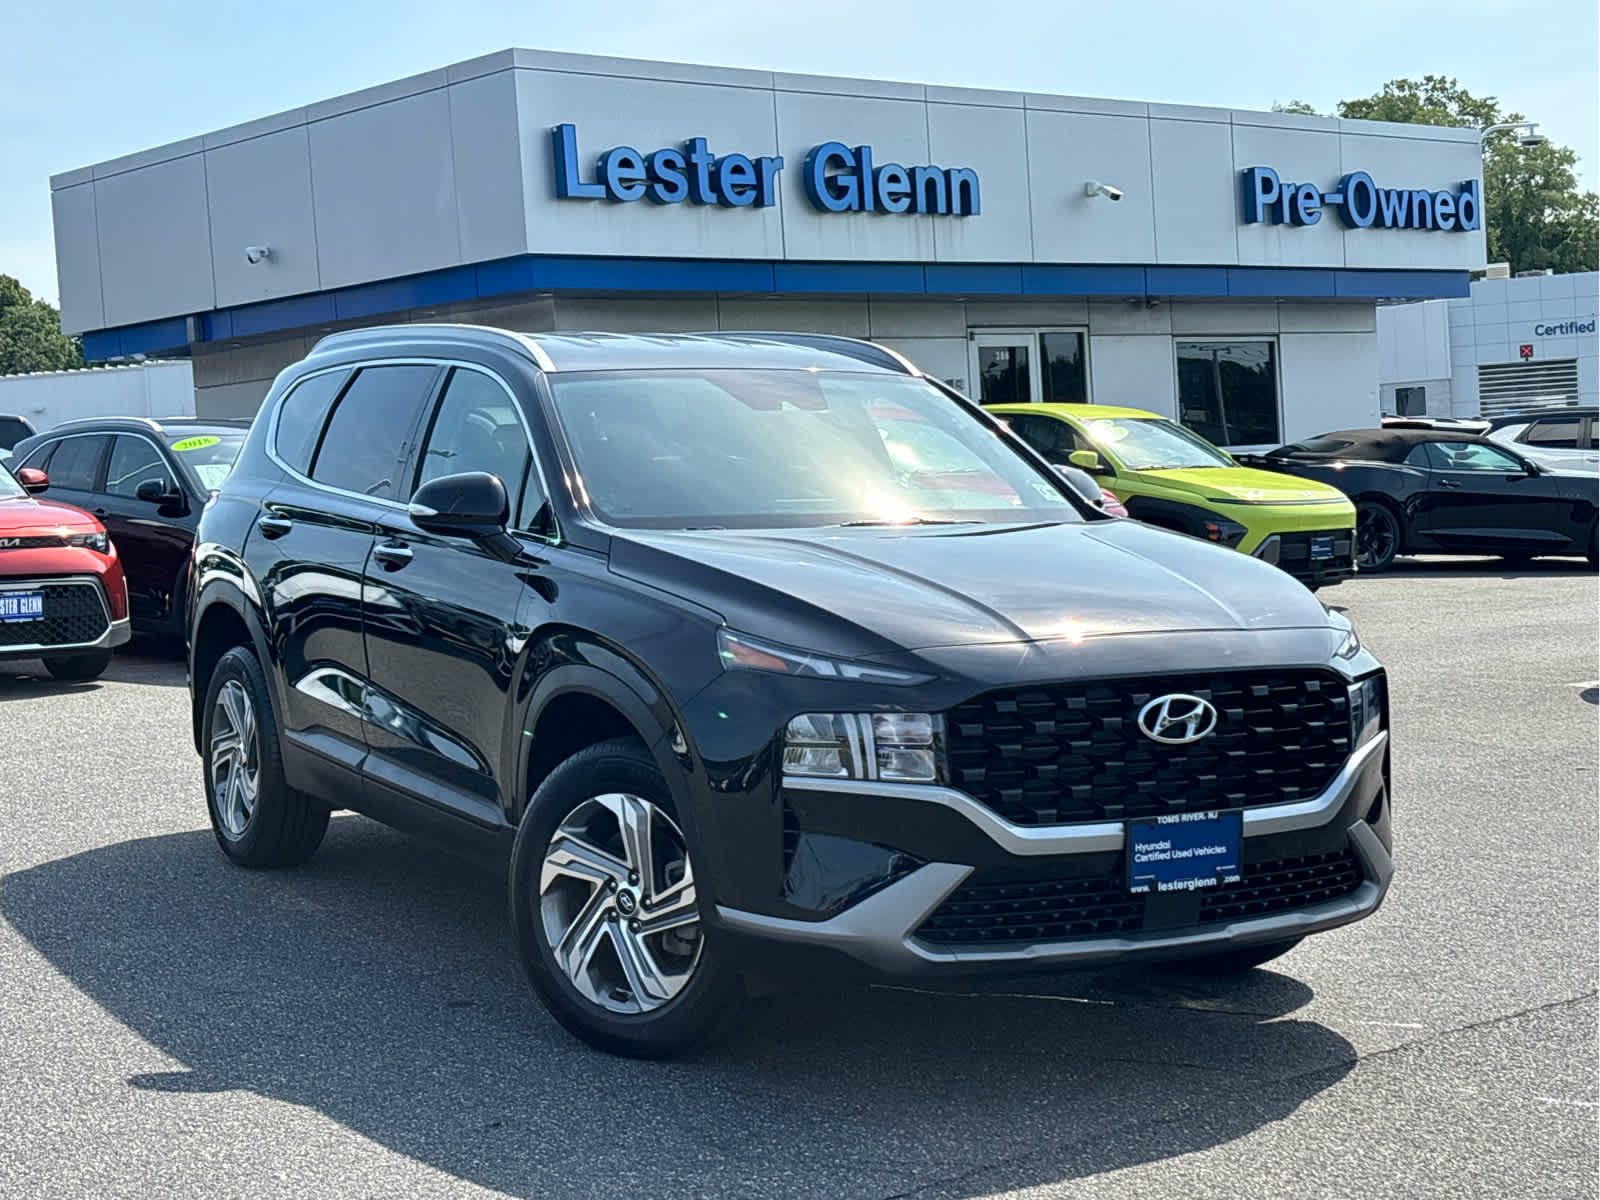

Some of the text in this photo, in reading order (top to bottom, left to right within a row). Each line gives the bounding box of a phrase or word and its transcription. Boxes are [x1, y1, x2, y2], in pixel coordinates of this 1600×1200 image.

[552, 123, 981, 217] Lester Glenn
[1243, 166, 1481, 231] Pre-Owned
[1535, 319, 1596, 336] Certified
[20, 597, 42, 612] GLENN
[1157, 814, 1180, 824] TOMS
[1134, 845, 1227, 863] Certified Used Vehicles
[1135, 840, 1171, 852] Hyundai
[1158, 877, 1217, 891] lesterglenn
